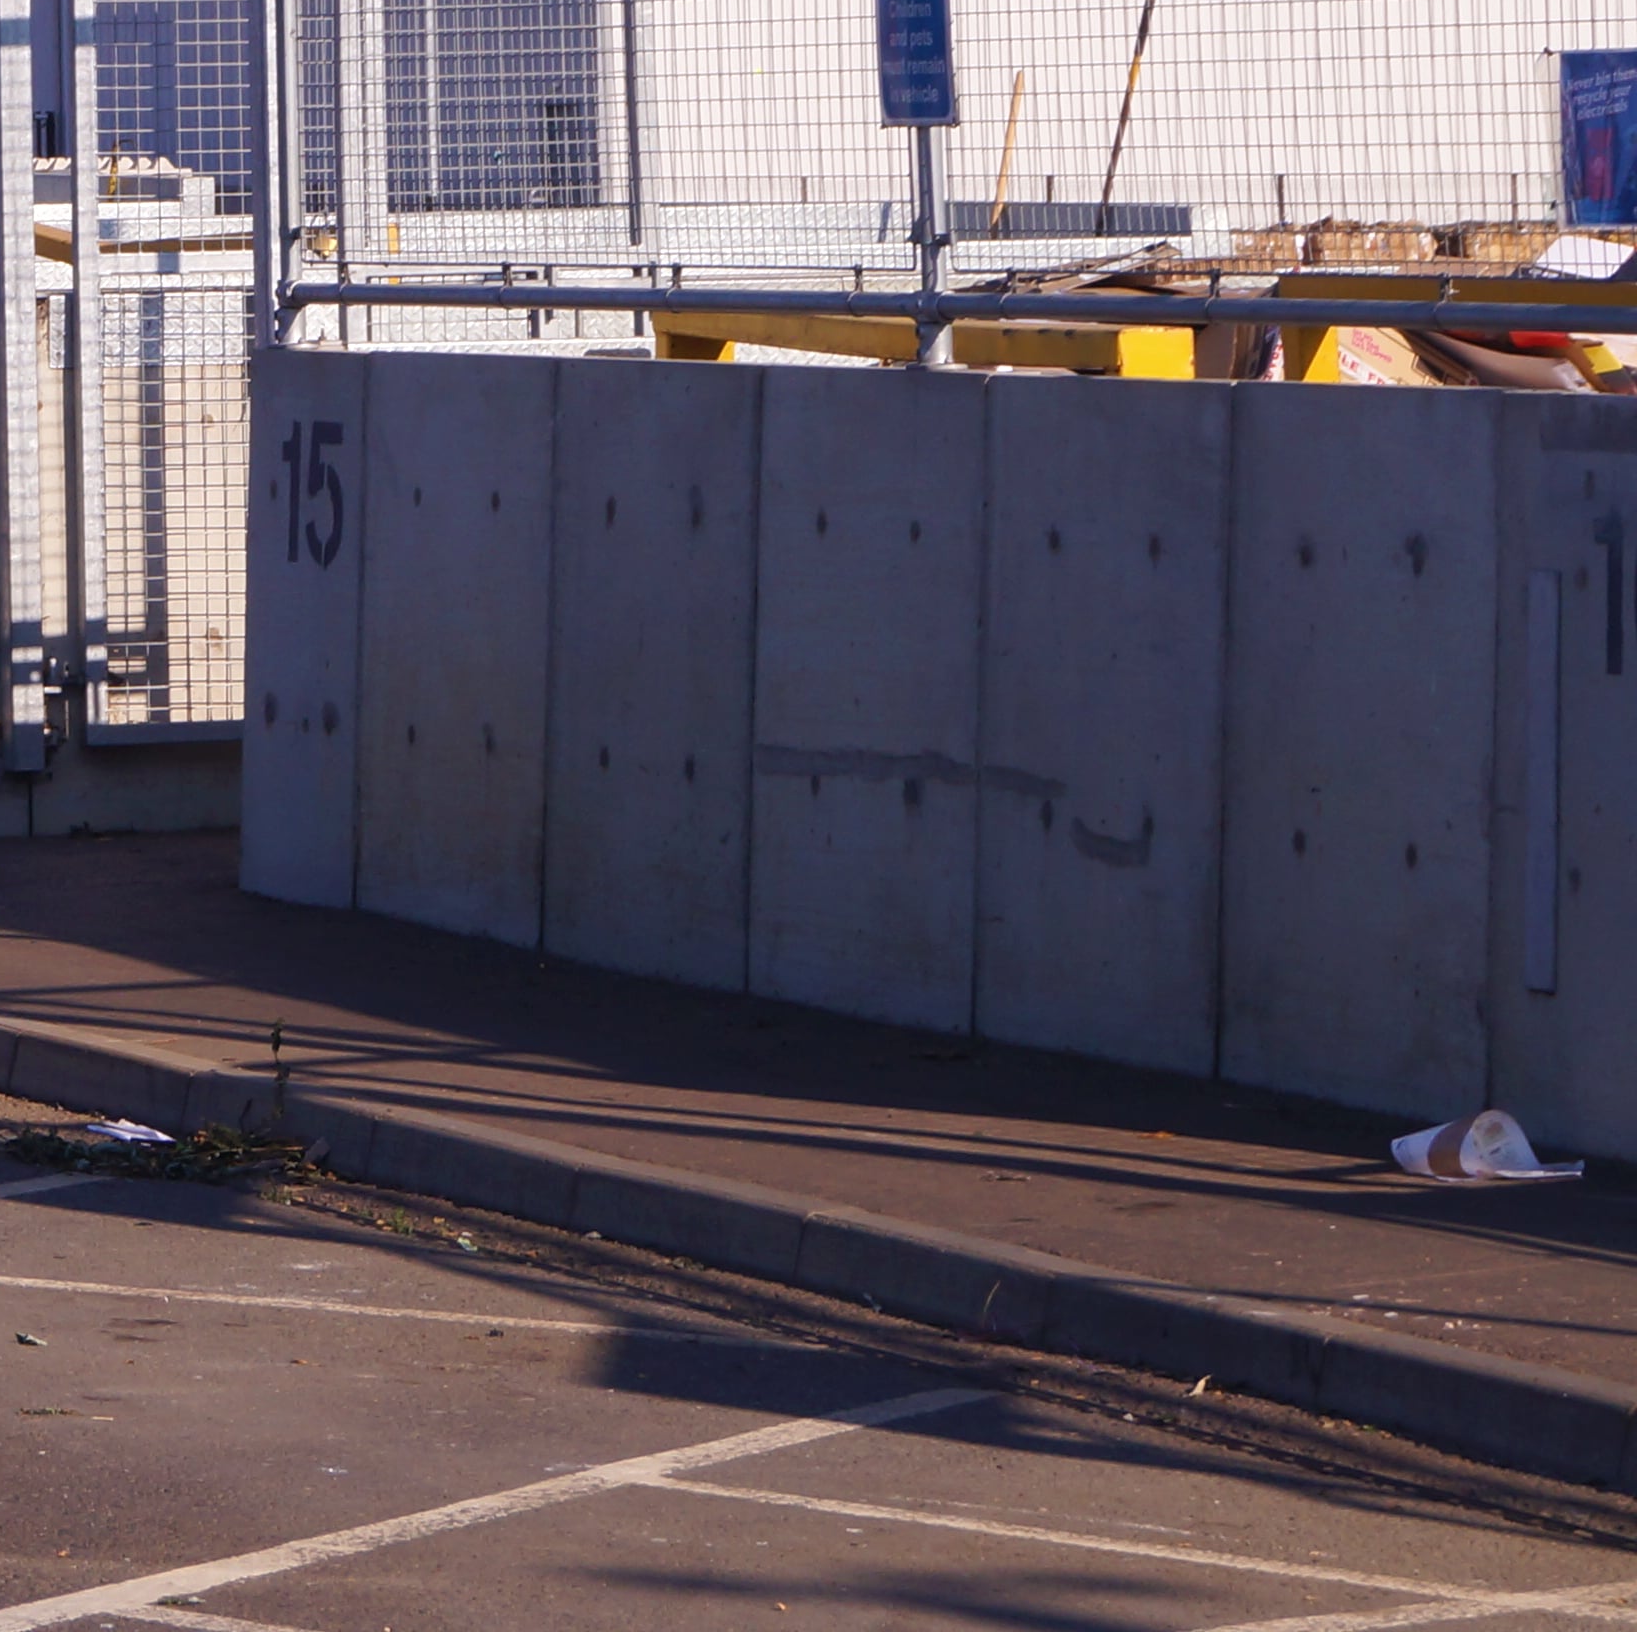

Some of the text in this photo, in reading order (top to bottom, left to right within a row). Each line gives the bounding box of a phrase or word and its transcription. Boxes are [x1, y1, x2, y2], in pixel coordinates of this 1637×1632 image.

[889, 0, 932, 18] Children
[889, 28, 933, 49] and pets
[282, 420, 344, 571] 15
